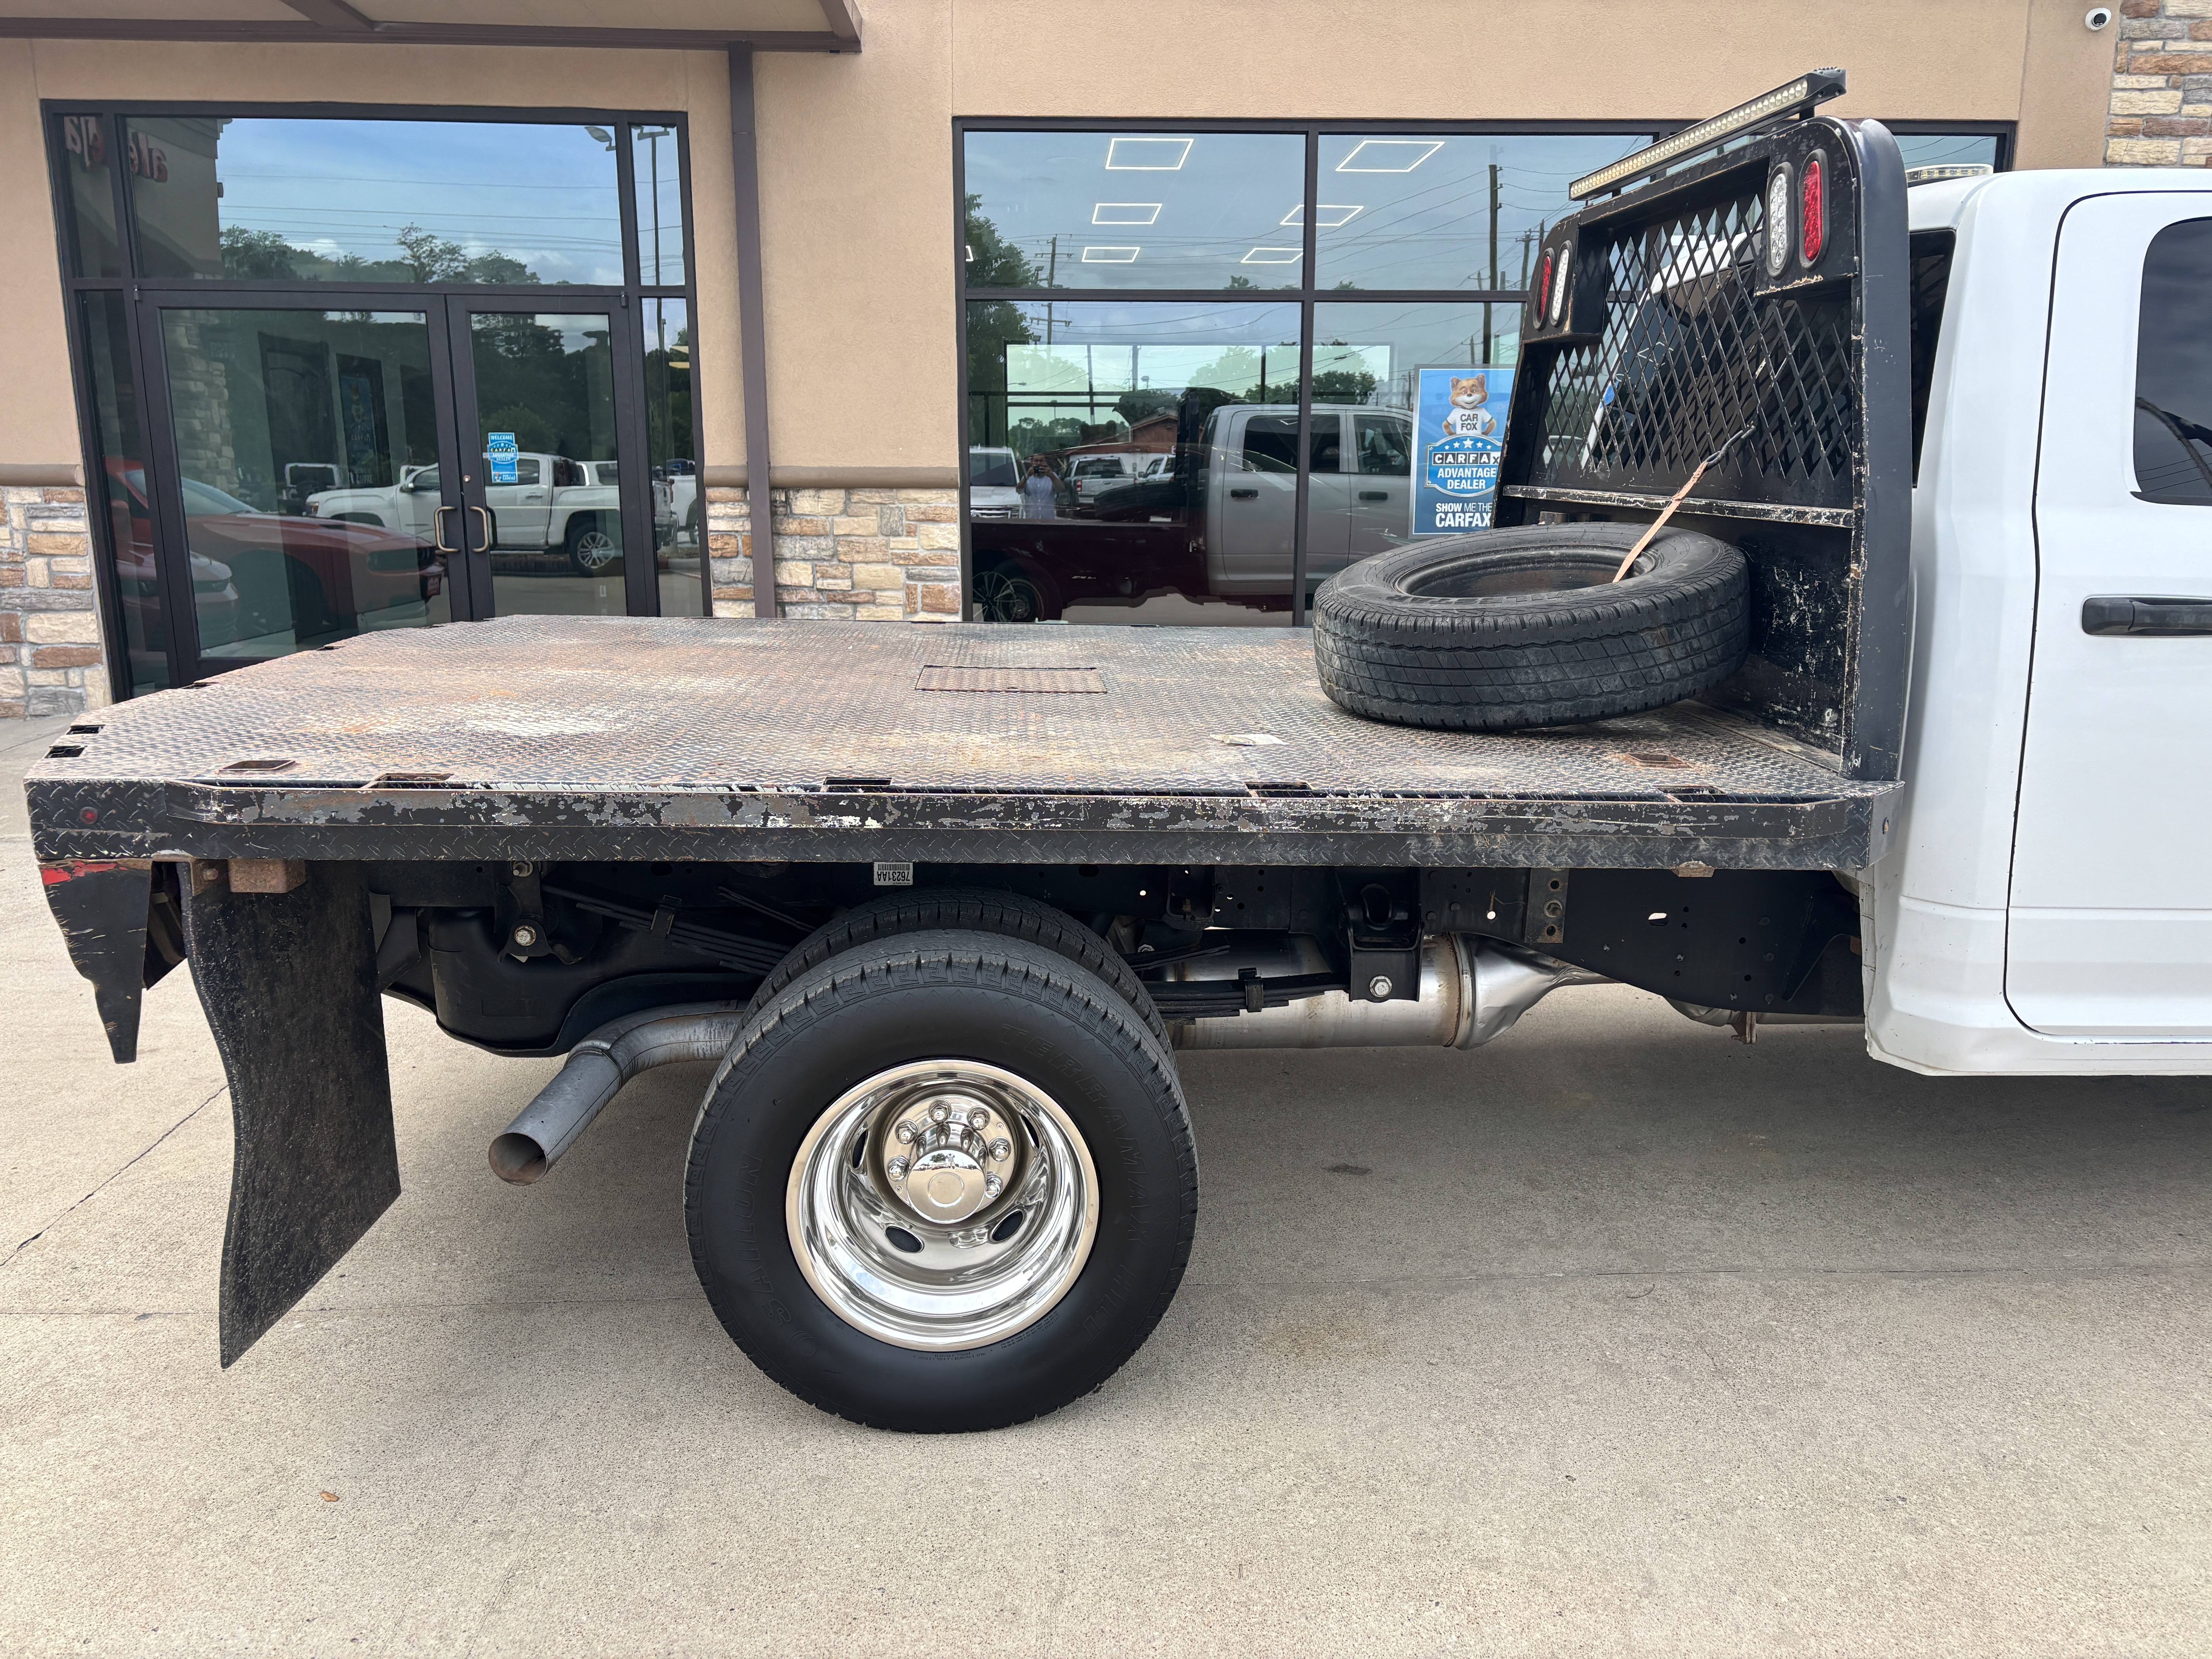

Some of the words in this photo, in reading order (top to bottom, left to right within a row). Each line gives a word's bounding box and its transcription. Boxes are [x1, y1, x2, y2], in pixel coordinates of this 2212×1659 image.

[1460, 413, 1478, 422] CAR
[1460, 422, 1477, 431] FOX
[1434, 453, 1500, 465] CARFAX
[1437, 467, 1497, 478] ADVANTAGE
[1447, 479, 1486, 489] DEALER
[1436, 503, 1463, 512] SHOW
[1464, 503, 1476, 512] ME
[1477, 502, 1493, 512] THE
[1435, 512, 1492, 527] CARFAX
[877, 871, 910, 882] 76231AA
[1001, 1023, 1151, 1245] TERRAMAX
[733, 1151, 793, 1328] SAILUN
